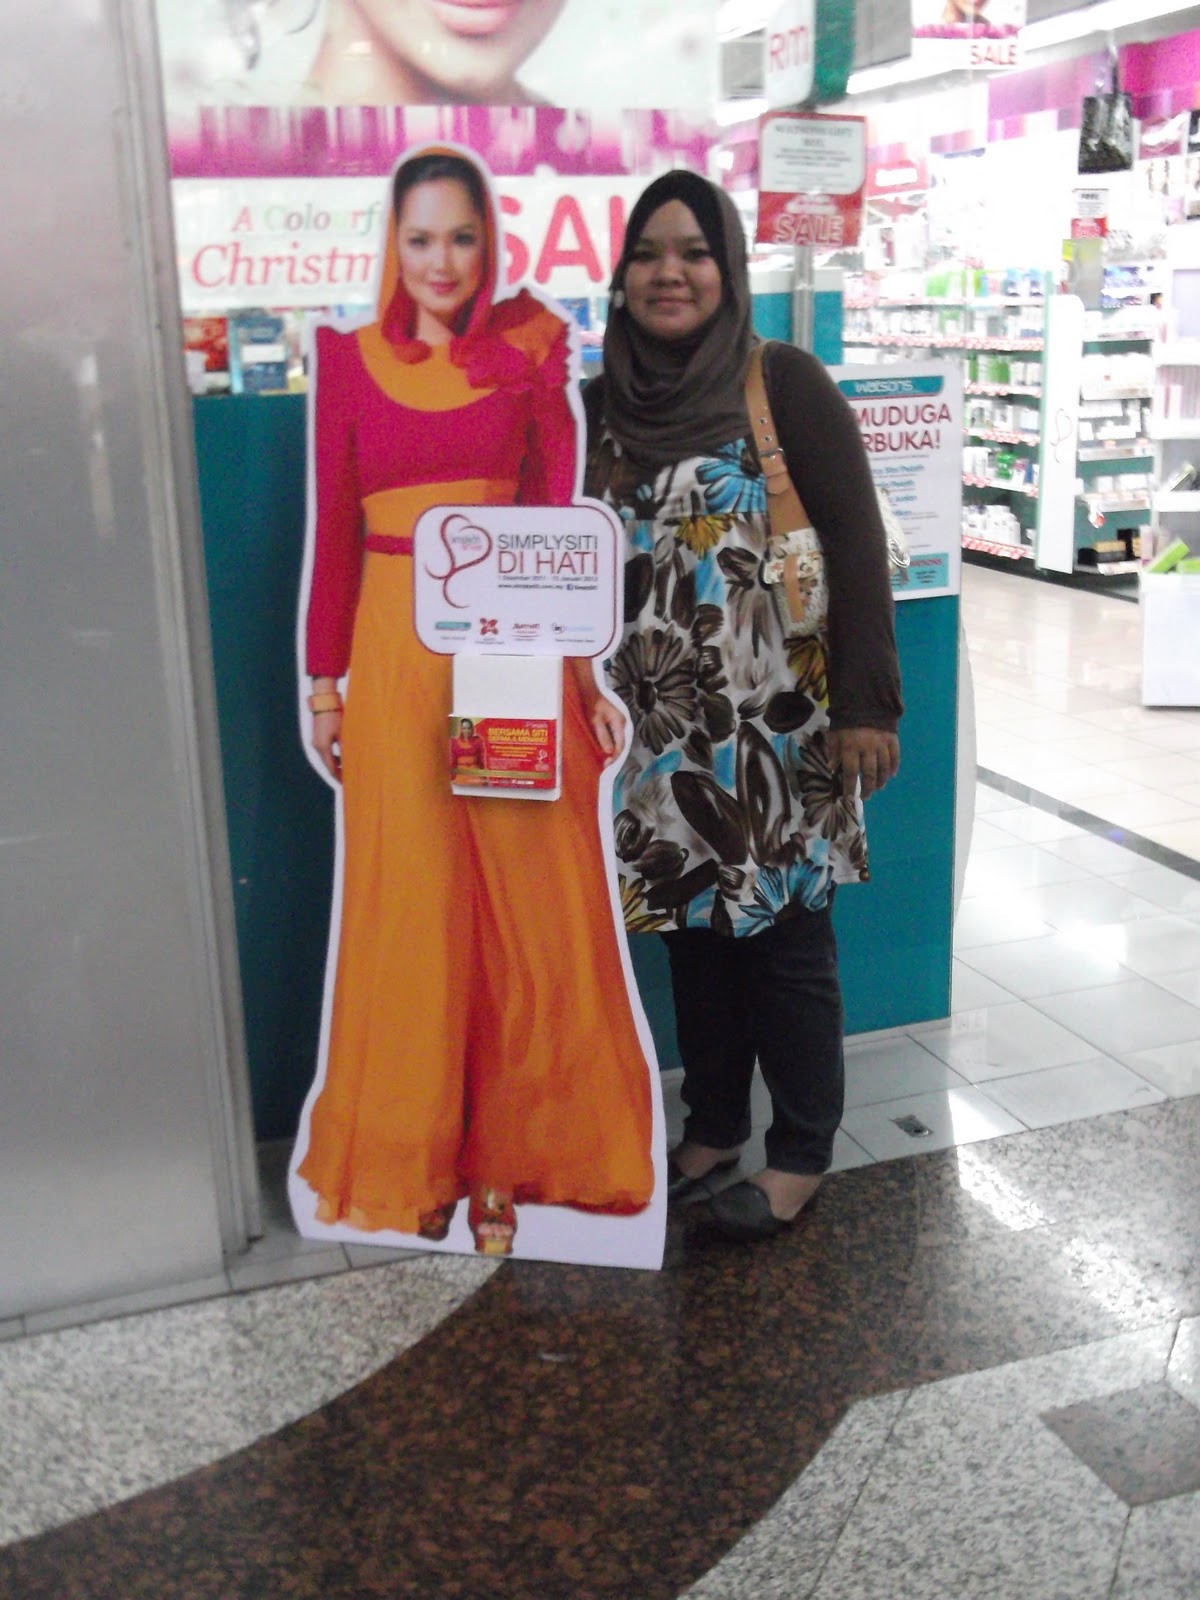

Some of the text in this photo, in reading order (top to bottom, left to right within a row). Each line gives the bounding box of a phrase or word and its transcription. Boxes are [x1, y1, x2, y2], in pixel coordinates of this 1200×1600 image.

[970, 44, 1017, 65] SALE
[231, 205, 254, 232] A
[774, 214, 844, 246] SALE
[498, 534, 598, 551] SIMPLYSITI
[498, 550, 598, 575] DI HATI
